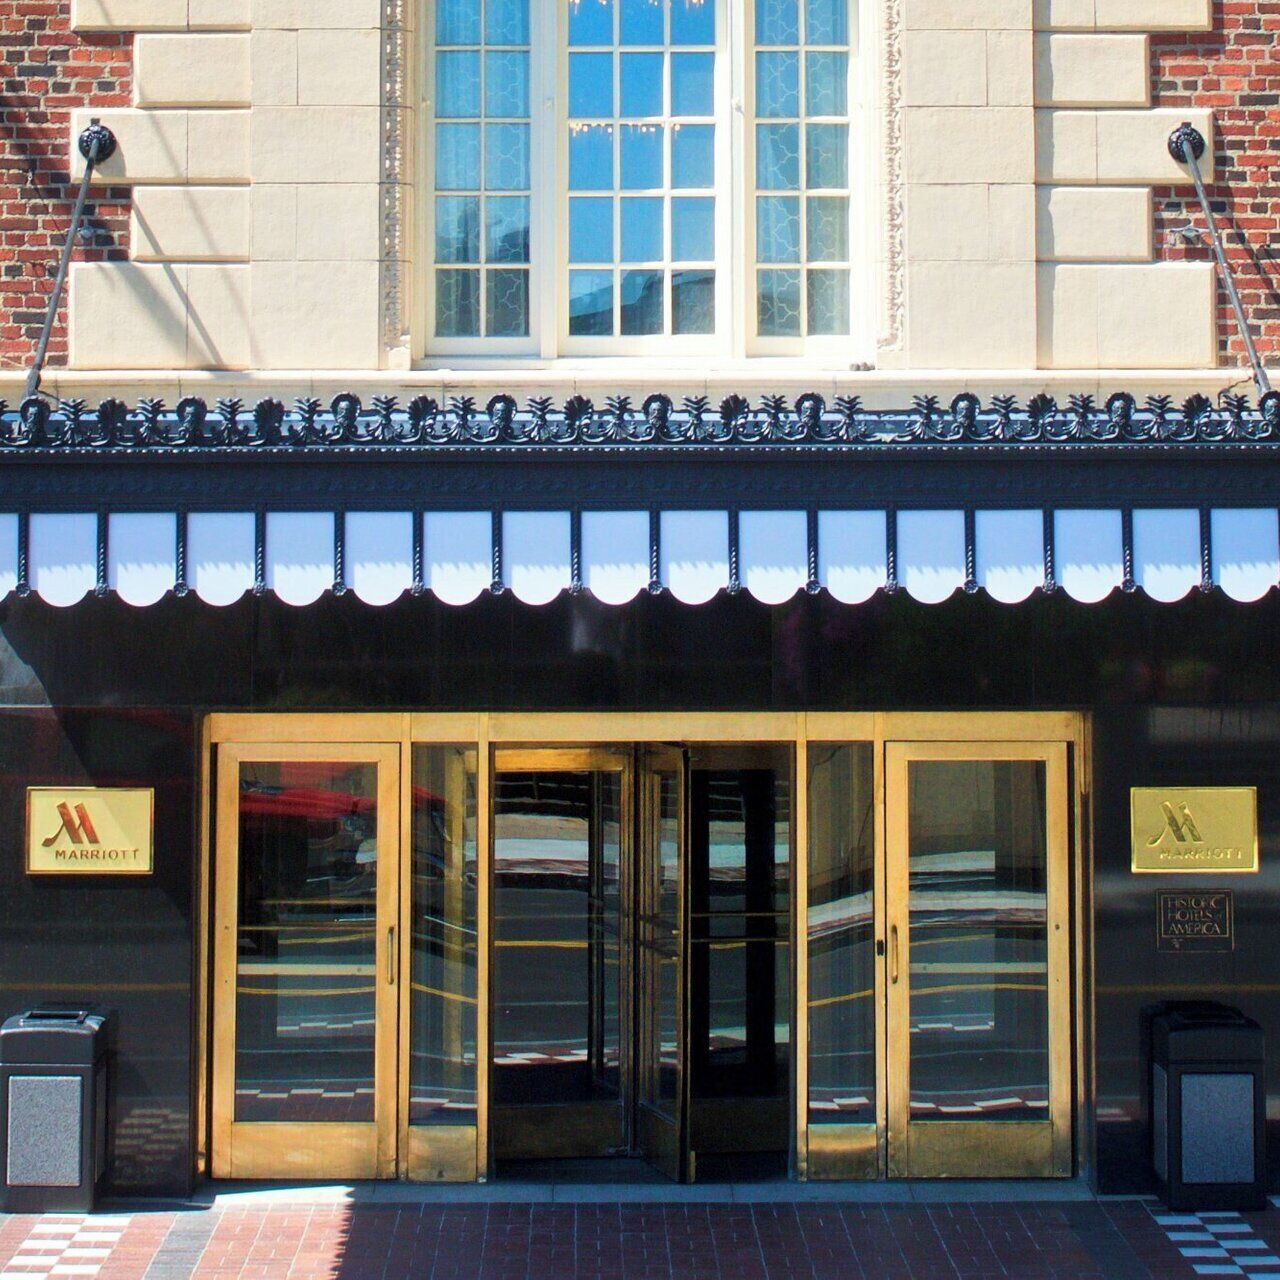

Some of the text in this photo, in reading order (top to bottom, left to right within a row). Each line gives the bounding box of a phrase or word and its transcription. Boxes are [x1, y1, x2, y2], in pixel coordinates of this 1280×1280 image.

[55, 848, 139, 860] MARRIOTT
[1159, 847, 1243, 860] MARRIOTT
[1168, 909, 1213, 921] HOTELS
[1168, 922, 1221, 935] AMERICA
